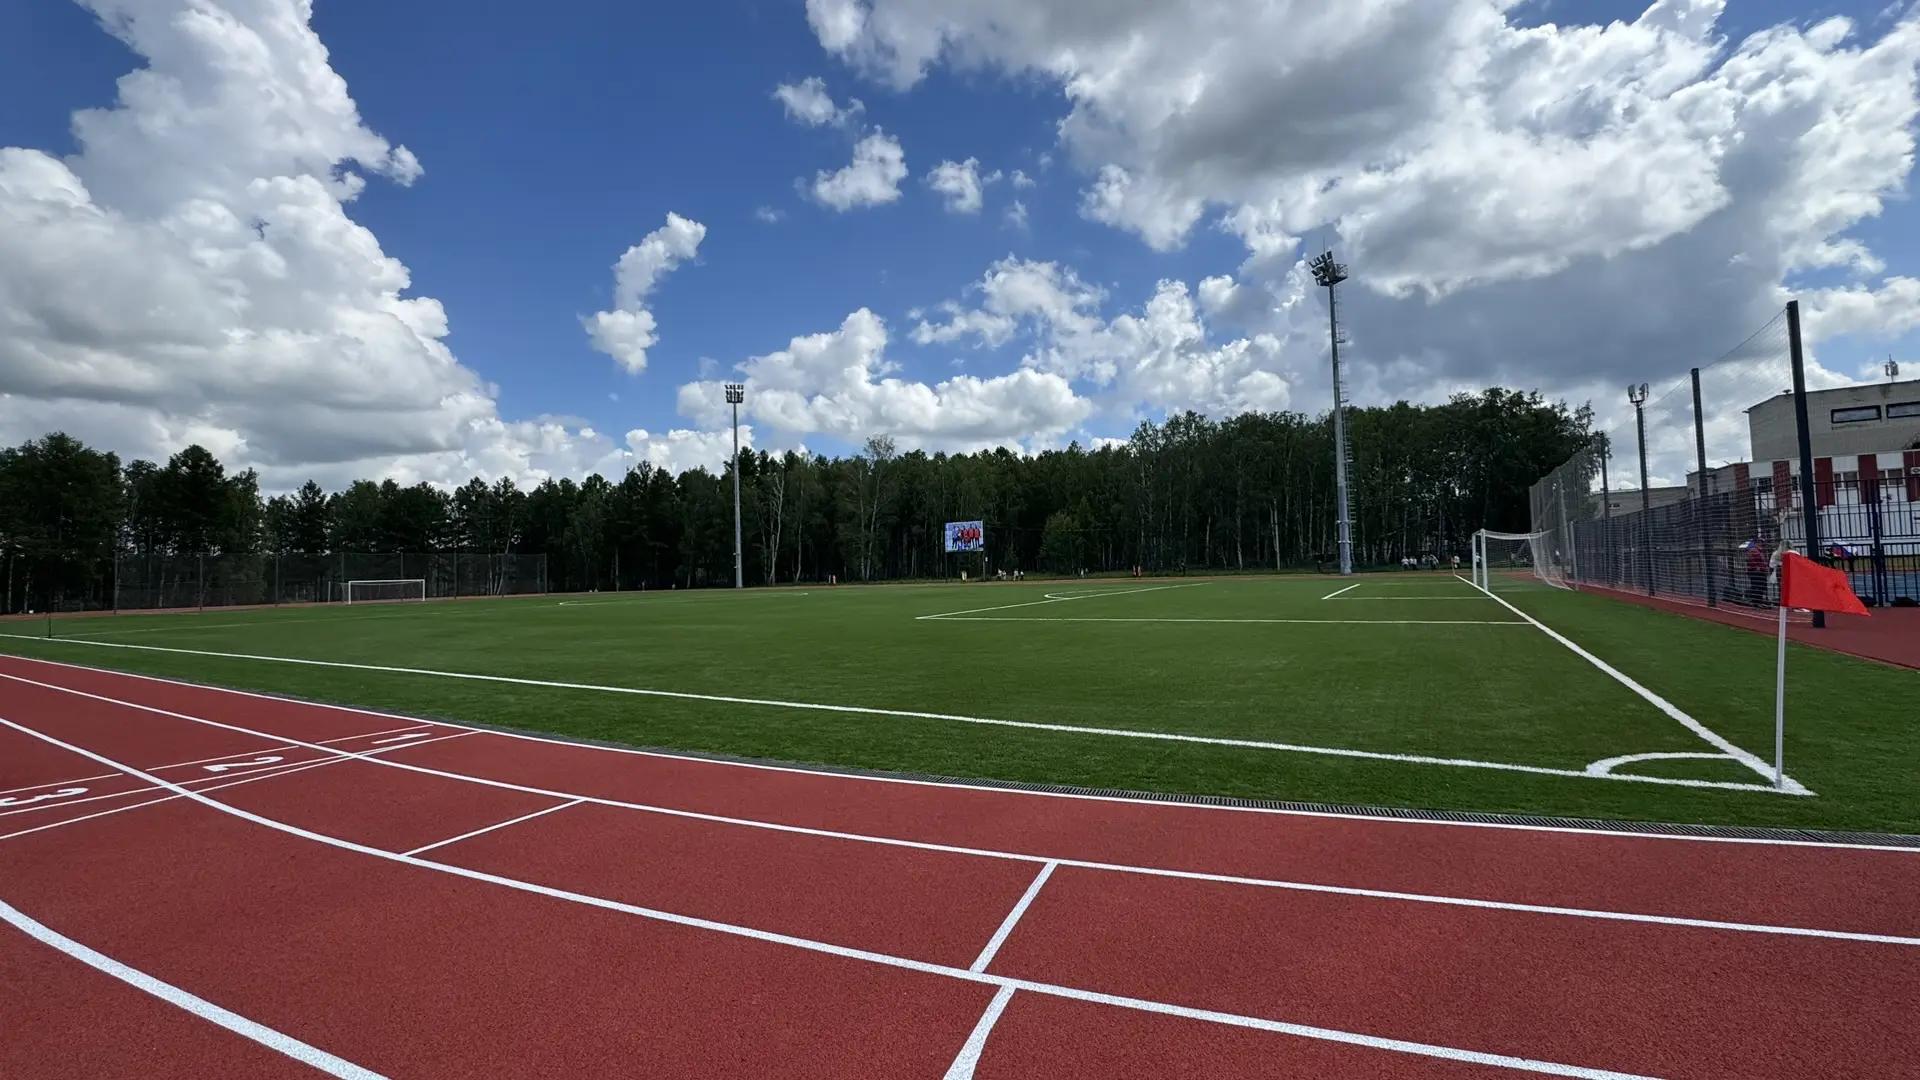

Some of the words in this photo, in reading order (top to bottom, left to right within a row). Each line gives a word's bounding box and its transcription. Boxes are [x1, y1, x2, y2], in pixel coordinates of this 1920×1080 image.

[371, 732, 432, 745] 1
[202, 756, 284, 773] 2
[0, 787, 89, 807] 3
